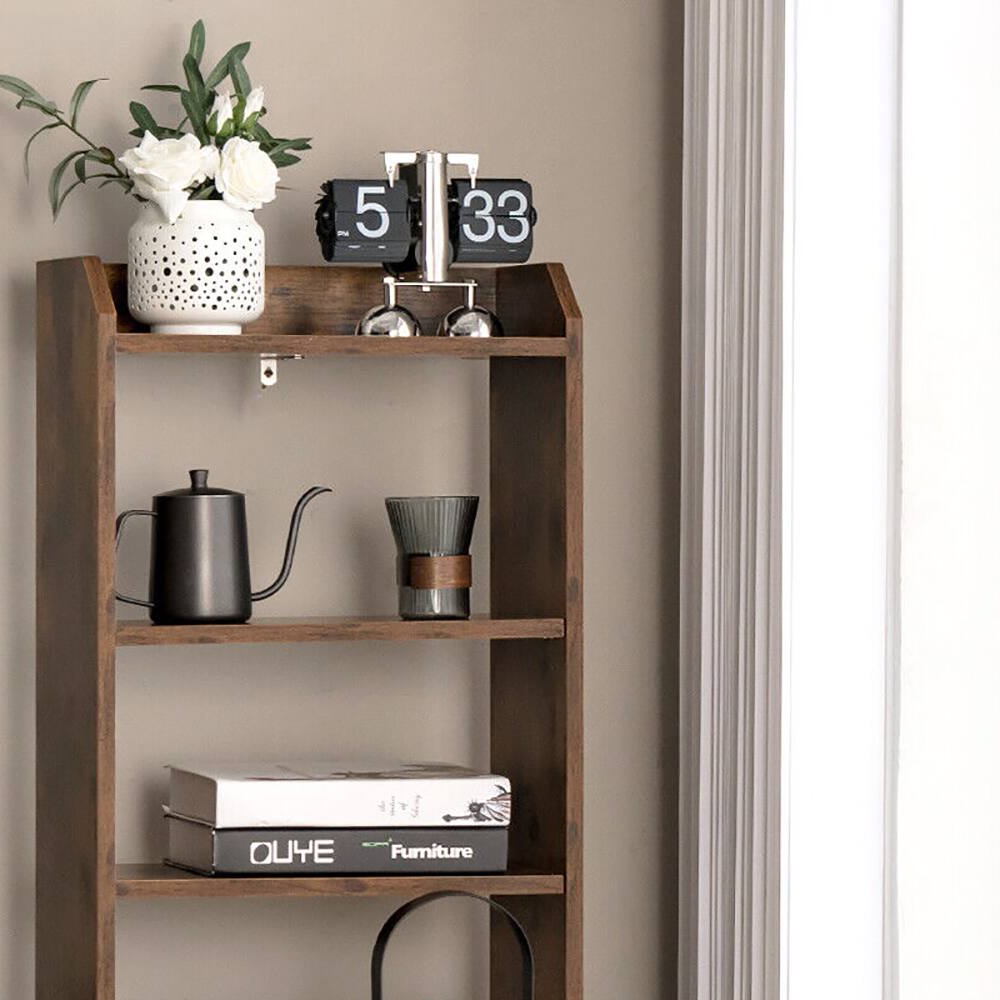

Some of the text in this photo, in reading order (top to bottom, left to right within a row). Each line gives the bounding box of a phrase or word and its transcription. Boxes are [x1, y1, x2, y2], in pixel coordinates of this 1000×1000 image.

[355, 186, 530, 244] 5 33
[391, 842, 474, 859] Furniture
